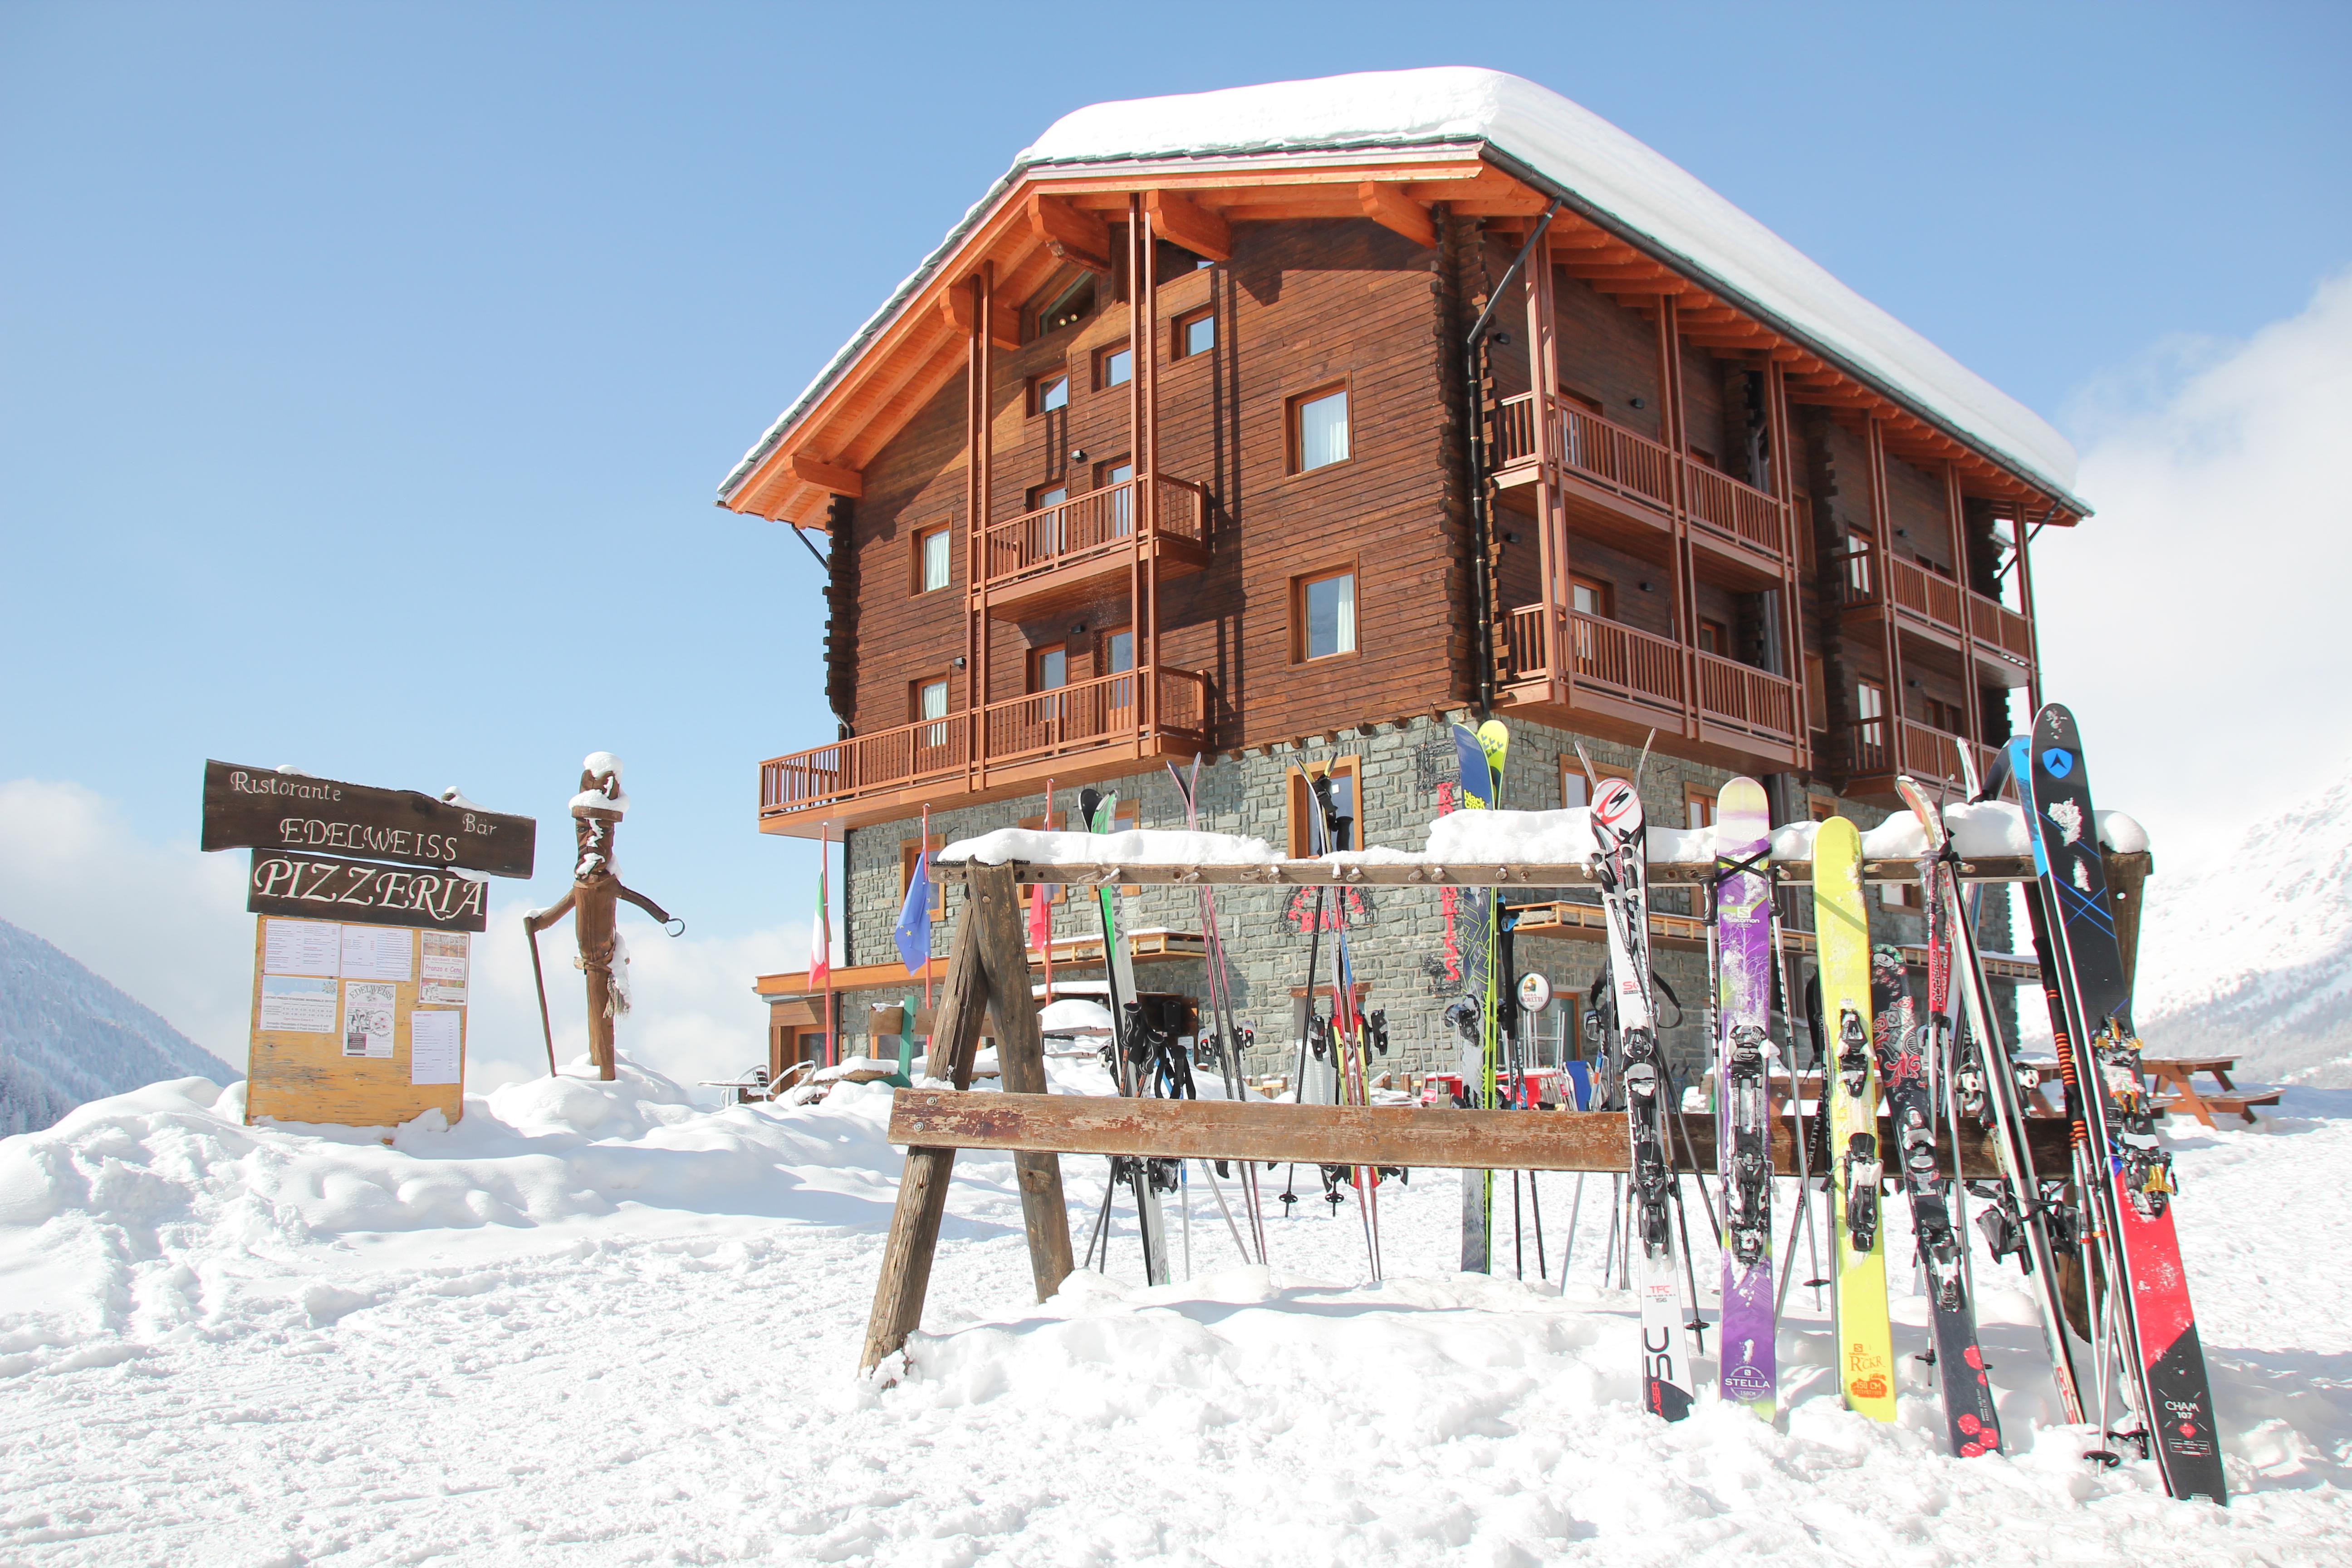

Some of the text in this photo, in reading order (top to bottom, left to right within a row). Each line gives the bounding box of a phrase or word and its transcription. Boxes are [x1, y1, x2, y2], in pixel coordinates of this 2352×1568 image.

[230, 772, 341, 802] Ristorante
[1464, 789, 1485, 809] black
[462, 813, 497, 837] Bar
[280, 818, 458, 862] EDELWEISS
[1615, 859, 1623, 882] SWISS
[254, 856, 483, 921] PIZZERIA
[1643, 1326, 1673, 1381] SC
[1725, 1377, 1771, 1389] STELLA
[1870, 1382, 1882, 1390] CM
[2164, 1401, 2200, 1412] CHAM
[2176, 1411, 2193, 1419] 107
